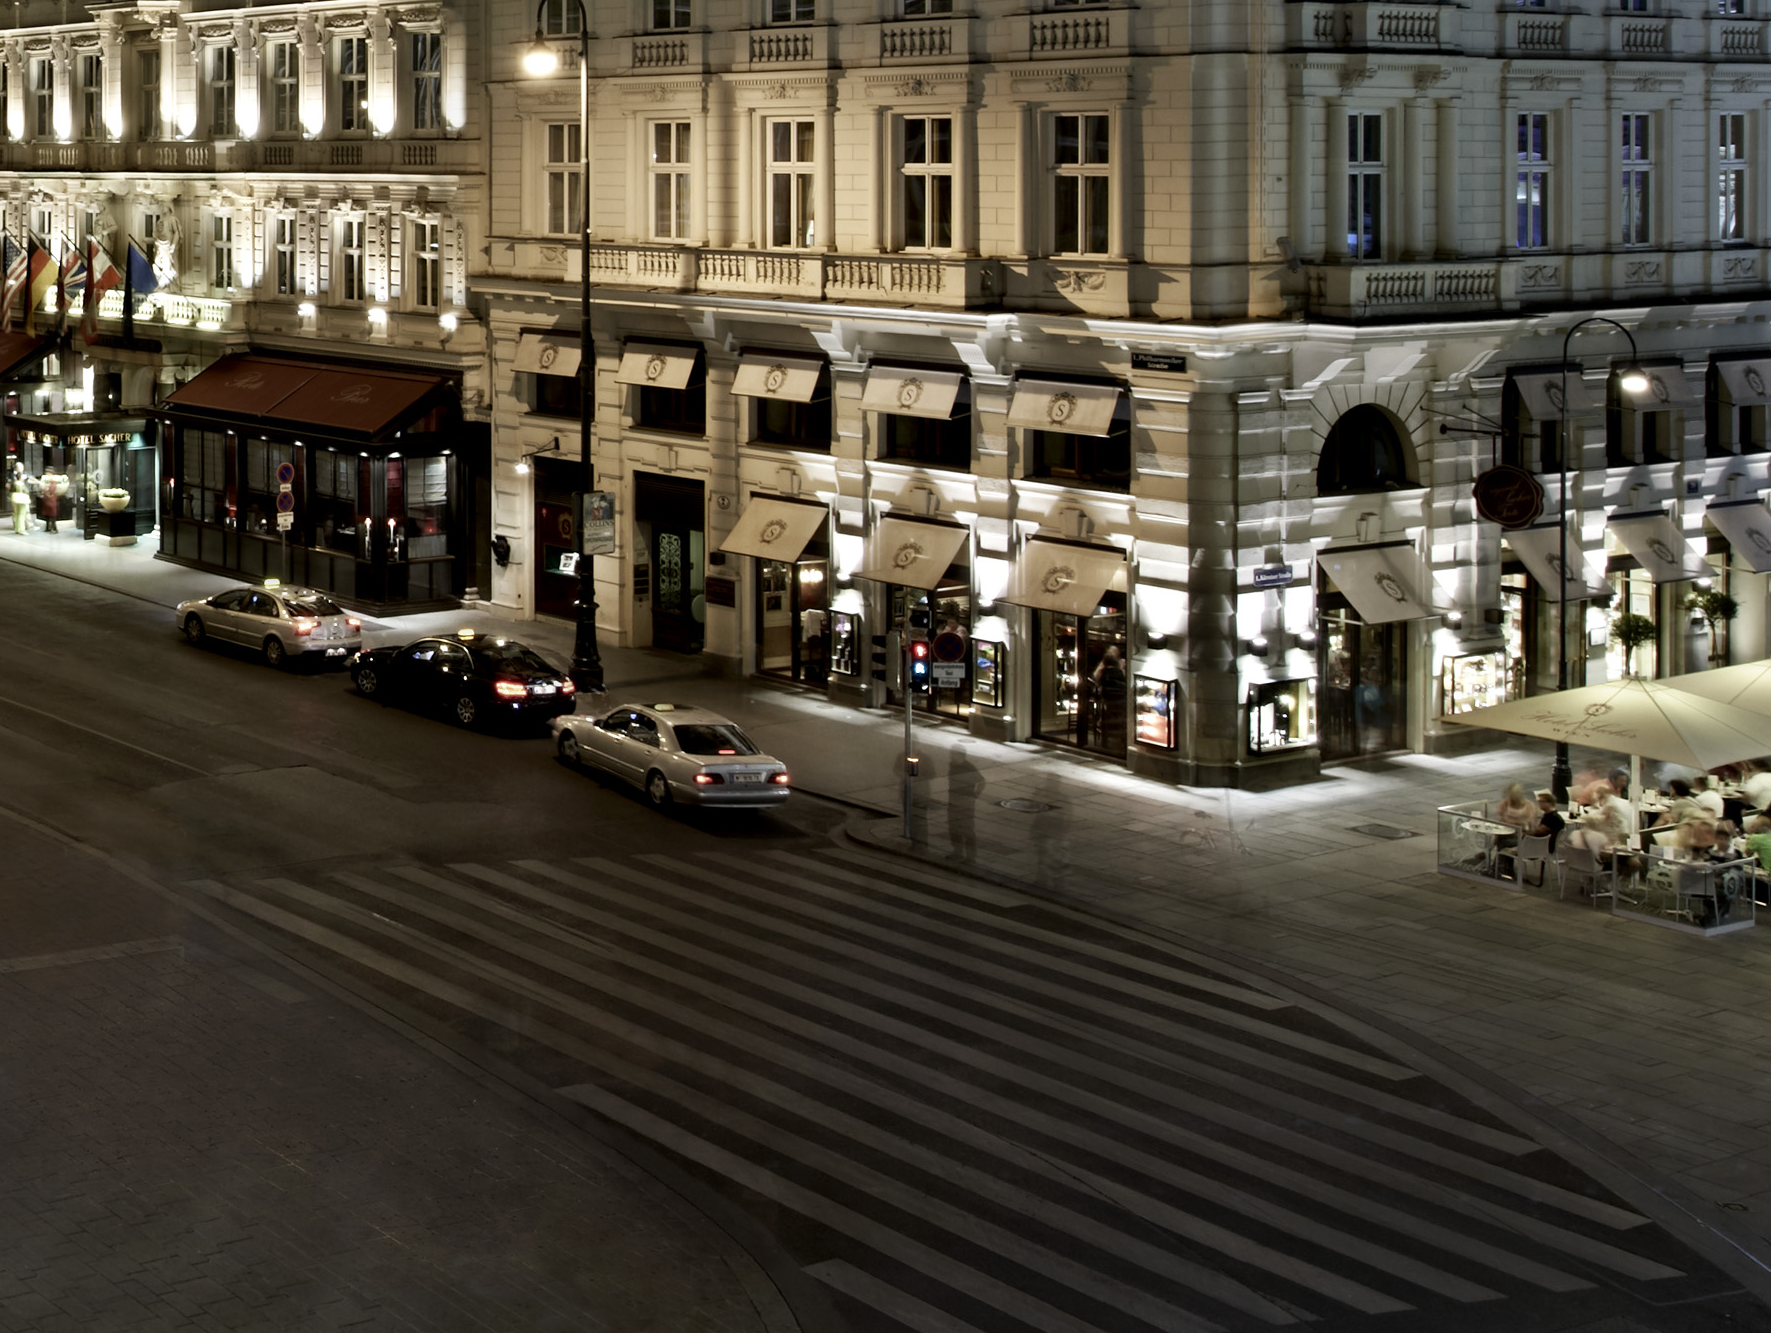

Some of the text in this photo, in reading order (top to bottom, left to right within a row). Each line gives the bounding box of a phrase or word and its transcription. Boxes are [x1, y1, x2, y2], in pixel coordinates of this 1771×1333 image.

[544, 353, 551, 363] S
[651, 365, 658, 375] S
[771, 375, 779, 386] S
[904, 388, 913, 400] S
[1056, 404, 1065, 417] S
[68, 433, 131, 445] HOTEL SACHER
[563, 521, 569, 533] S
[768, 527, 777, 538] S
[902, 551, 911, 563] S
[1050, 576, 1060, 587] S
[1386, 582, 1398, 596] S
